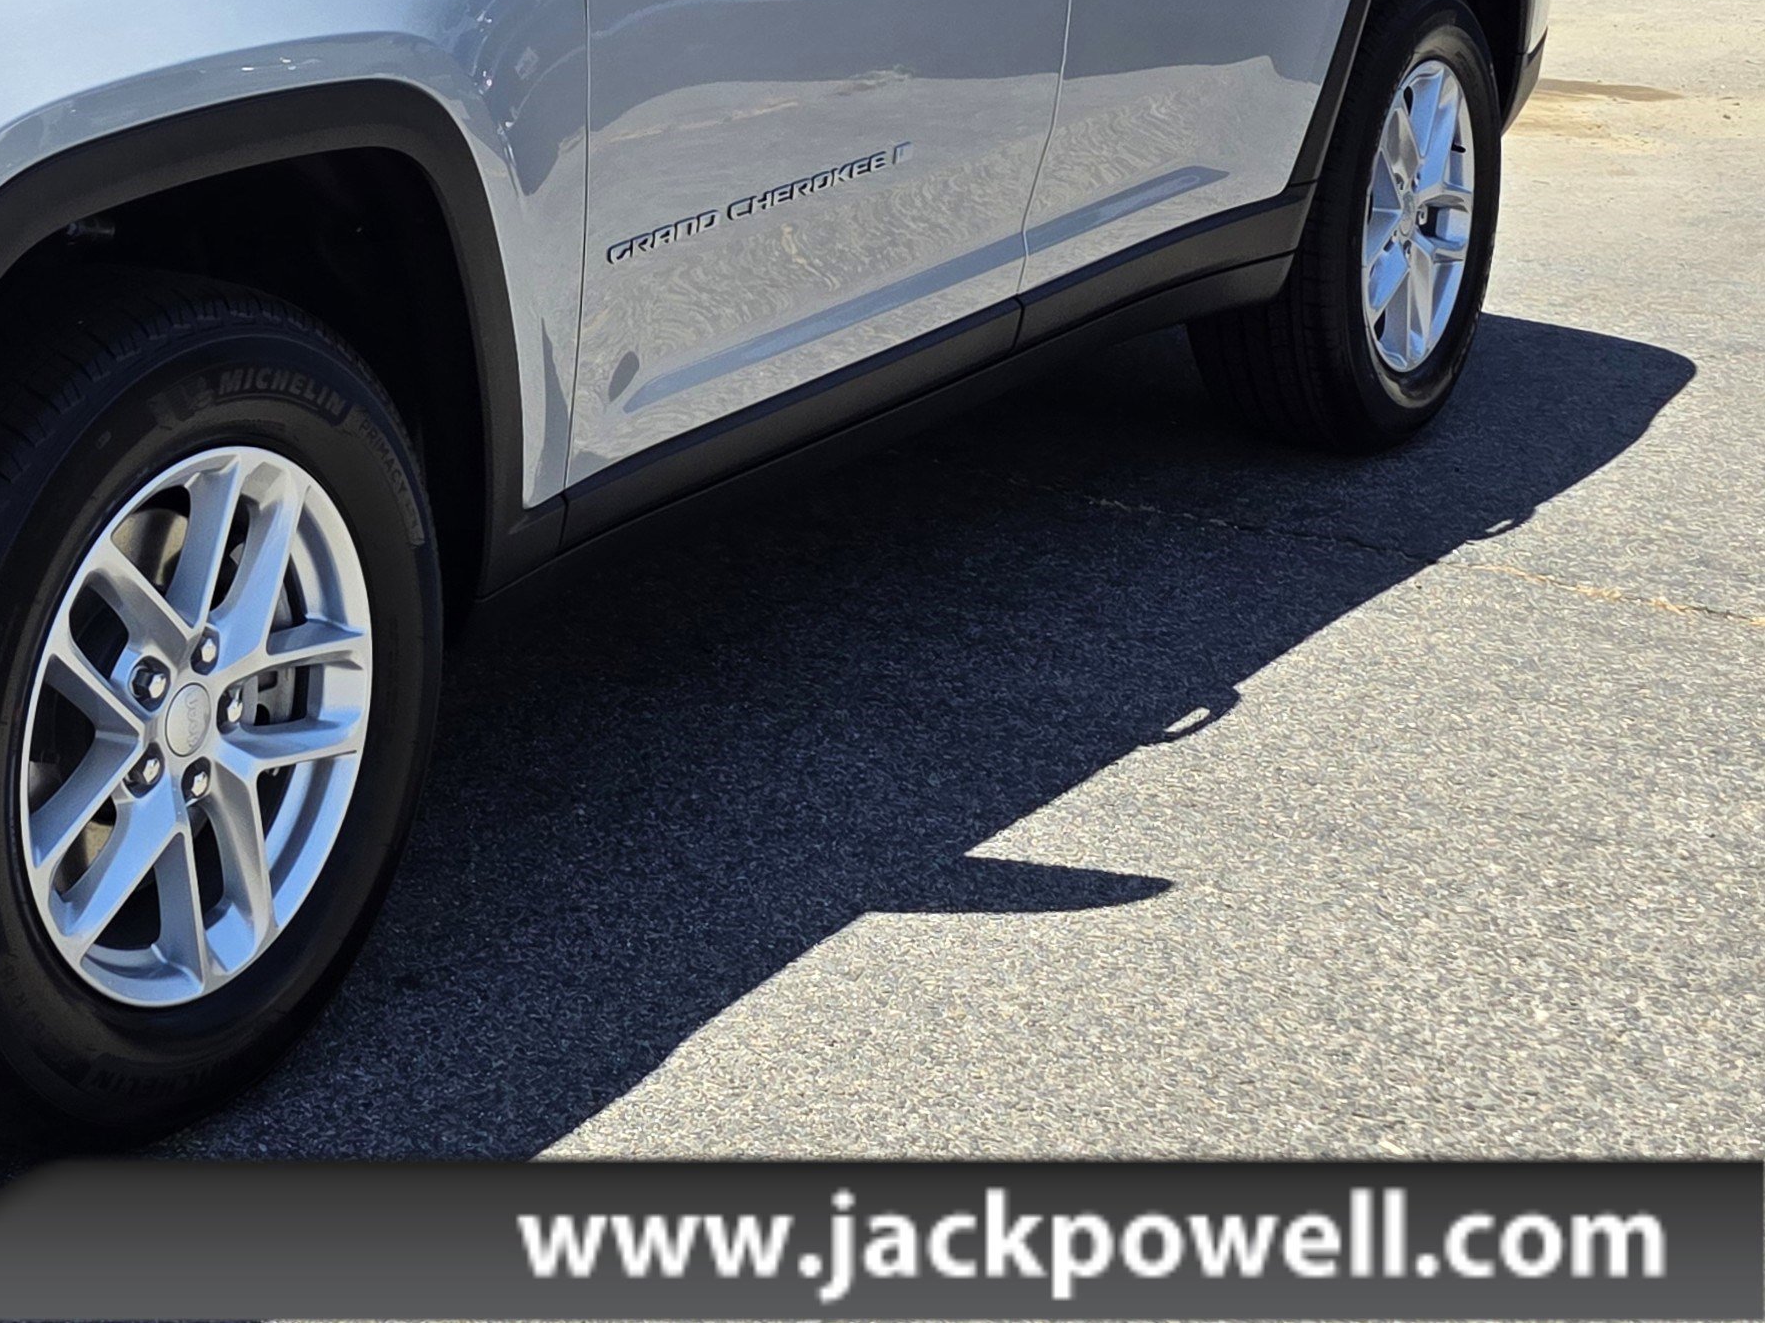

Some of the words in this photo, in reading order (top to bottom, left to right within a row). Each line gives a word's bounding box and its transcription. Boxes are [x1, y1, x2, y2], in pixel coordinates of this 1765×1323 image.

[606, 209, 721, 265] GRAND
[726, 151, 888, 221] CHEROKEE
[218, 367, 348, 418] MICHELIN
